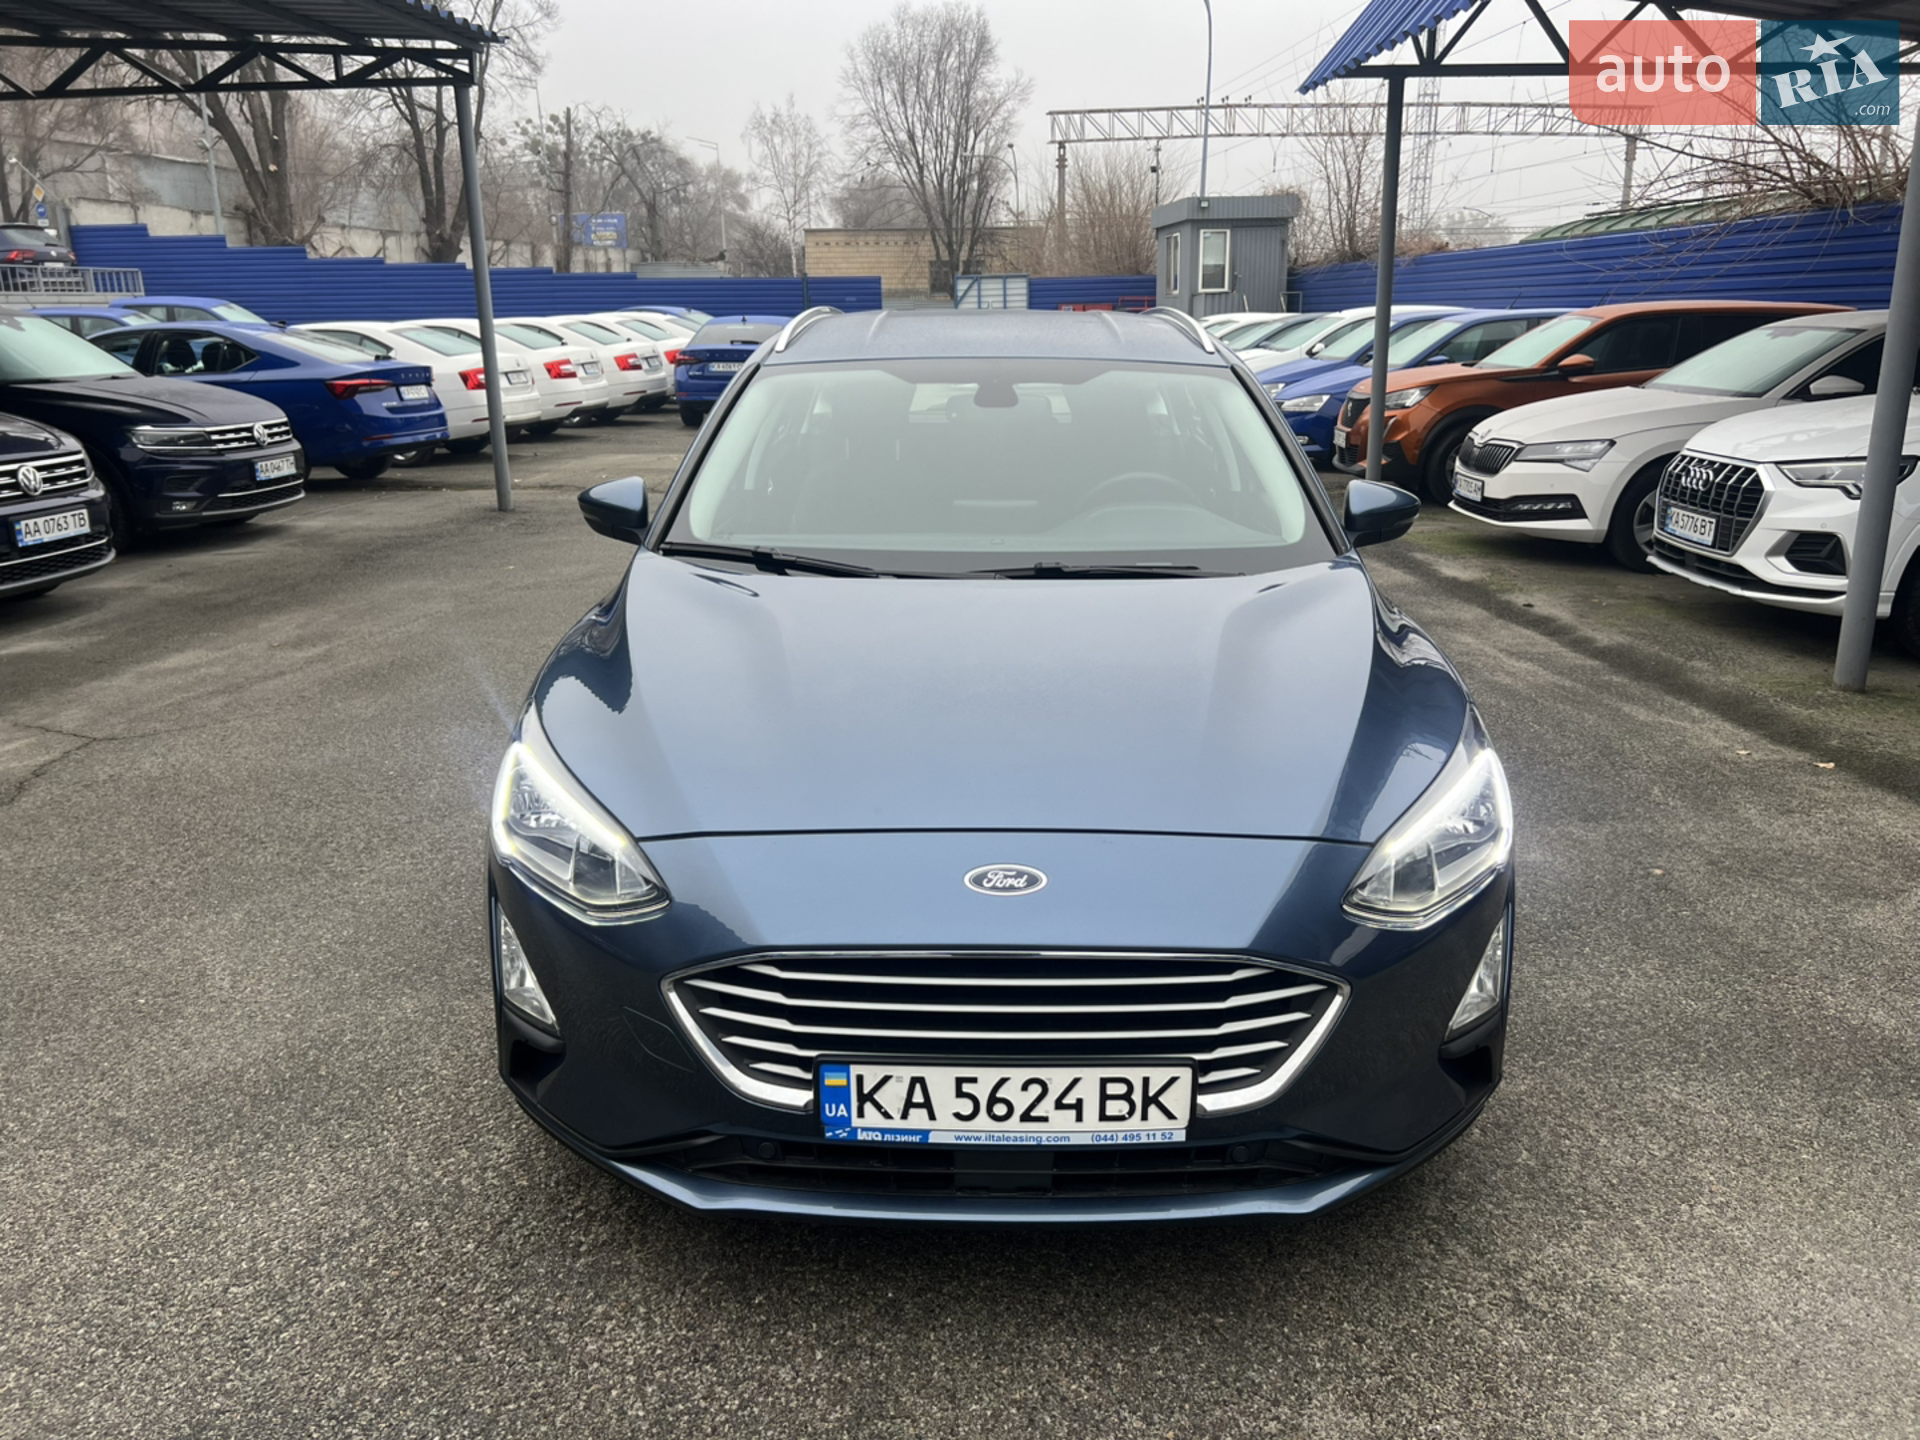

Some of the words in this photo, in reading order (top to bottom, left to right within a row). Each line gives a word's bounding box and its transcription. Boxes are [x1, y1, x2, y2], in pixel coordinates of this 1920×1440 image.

[24, 521, 42, 539] AA
[43, 515, 70, 535] 0763
[70, 512, 87, 529] TB
[1680, 513, 1700, 534] 5776
[1700, 519, 1714, 537] BT
[982, 869, 1029, 888] Ford
[855, 1073, 937, 1122] KA
[951, 1076, 1084, 1123] 5624
[1098, 1076, 1181, 1122] BK
[824, 1103, 849, 1118] UA
[953, 1132, 1071, 1145] www.iltaleasing.com
[1090, 1132, 1119, 1144] (044)
[1121, 1132, 1142, 1143] 495
[1145, 1132, 1157, 1142] 11
[1160, 1131, 1175, 1141] 52
